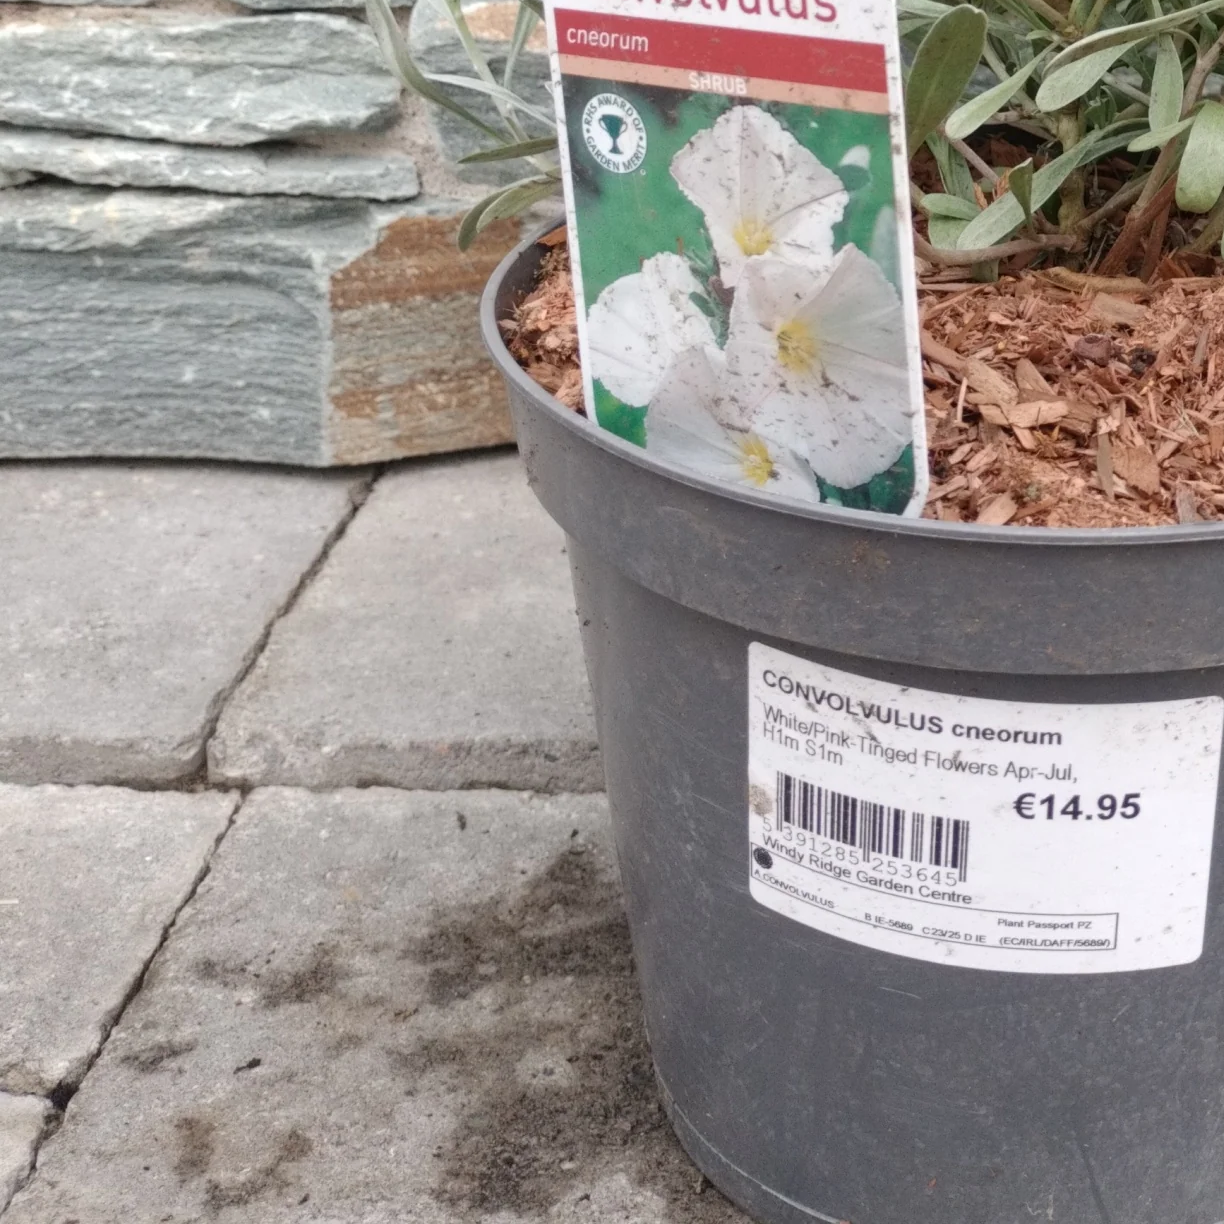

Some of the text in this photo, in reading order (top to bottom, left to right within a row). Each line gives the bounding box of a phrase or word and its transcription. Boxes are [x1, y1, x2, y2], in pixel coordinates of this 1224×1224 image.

[566, 26, 649, 52] cneorum
[688, 72, 748, 96] SHRUB
[584, 96, 644, 134] RHS AWARD OF
[586, 136, 645, 171] GARDEN MERIT
[762, 669, 1063, 746] CONVOLVULUS cneorum
[763, 702, 1078, 783] White/Pink-Tinged Flowers Apr-Jul,
[763, 722, 843, 765] H1m S1m
[1012, 792, 1142, 821] €14.95
[762, 832, 973, 905] Windy Ridge Garden Centre
[782, 826, 860, 865] 391285
[872, 857, 958, 887] 253645
[763, 874, 836, 909] CONVOLVULUS
[997, 918, 1093, 931] Plant Passport PZ
